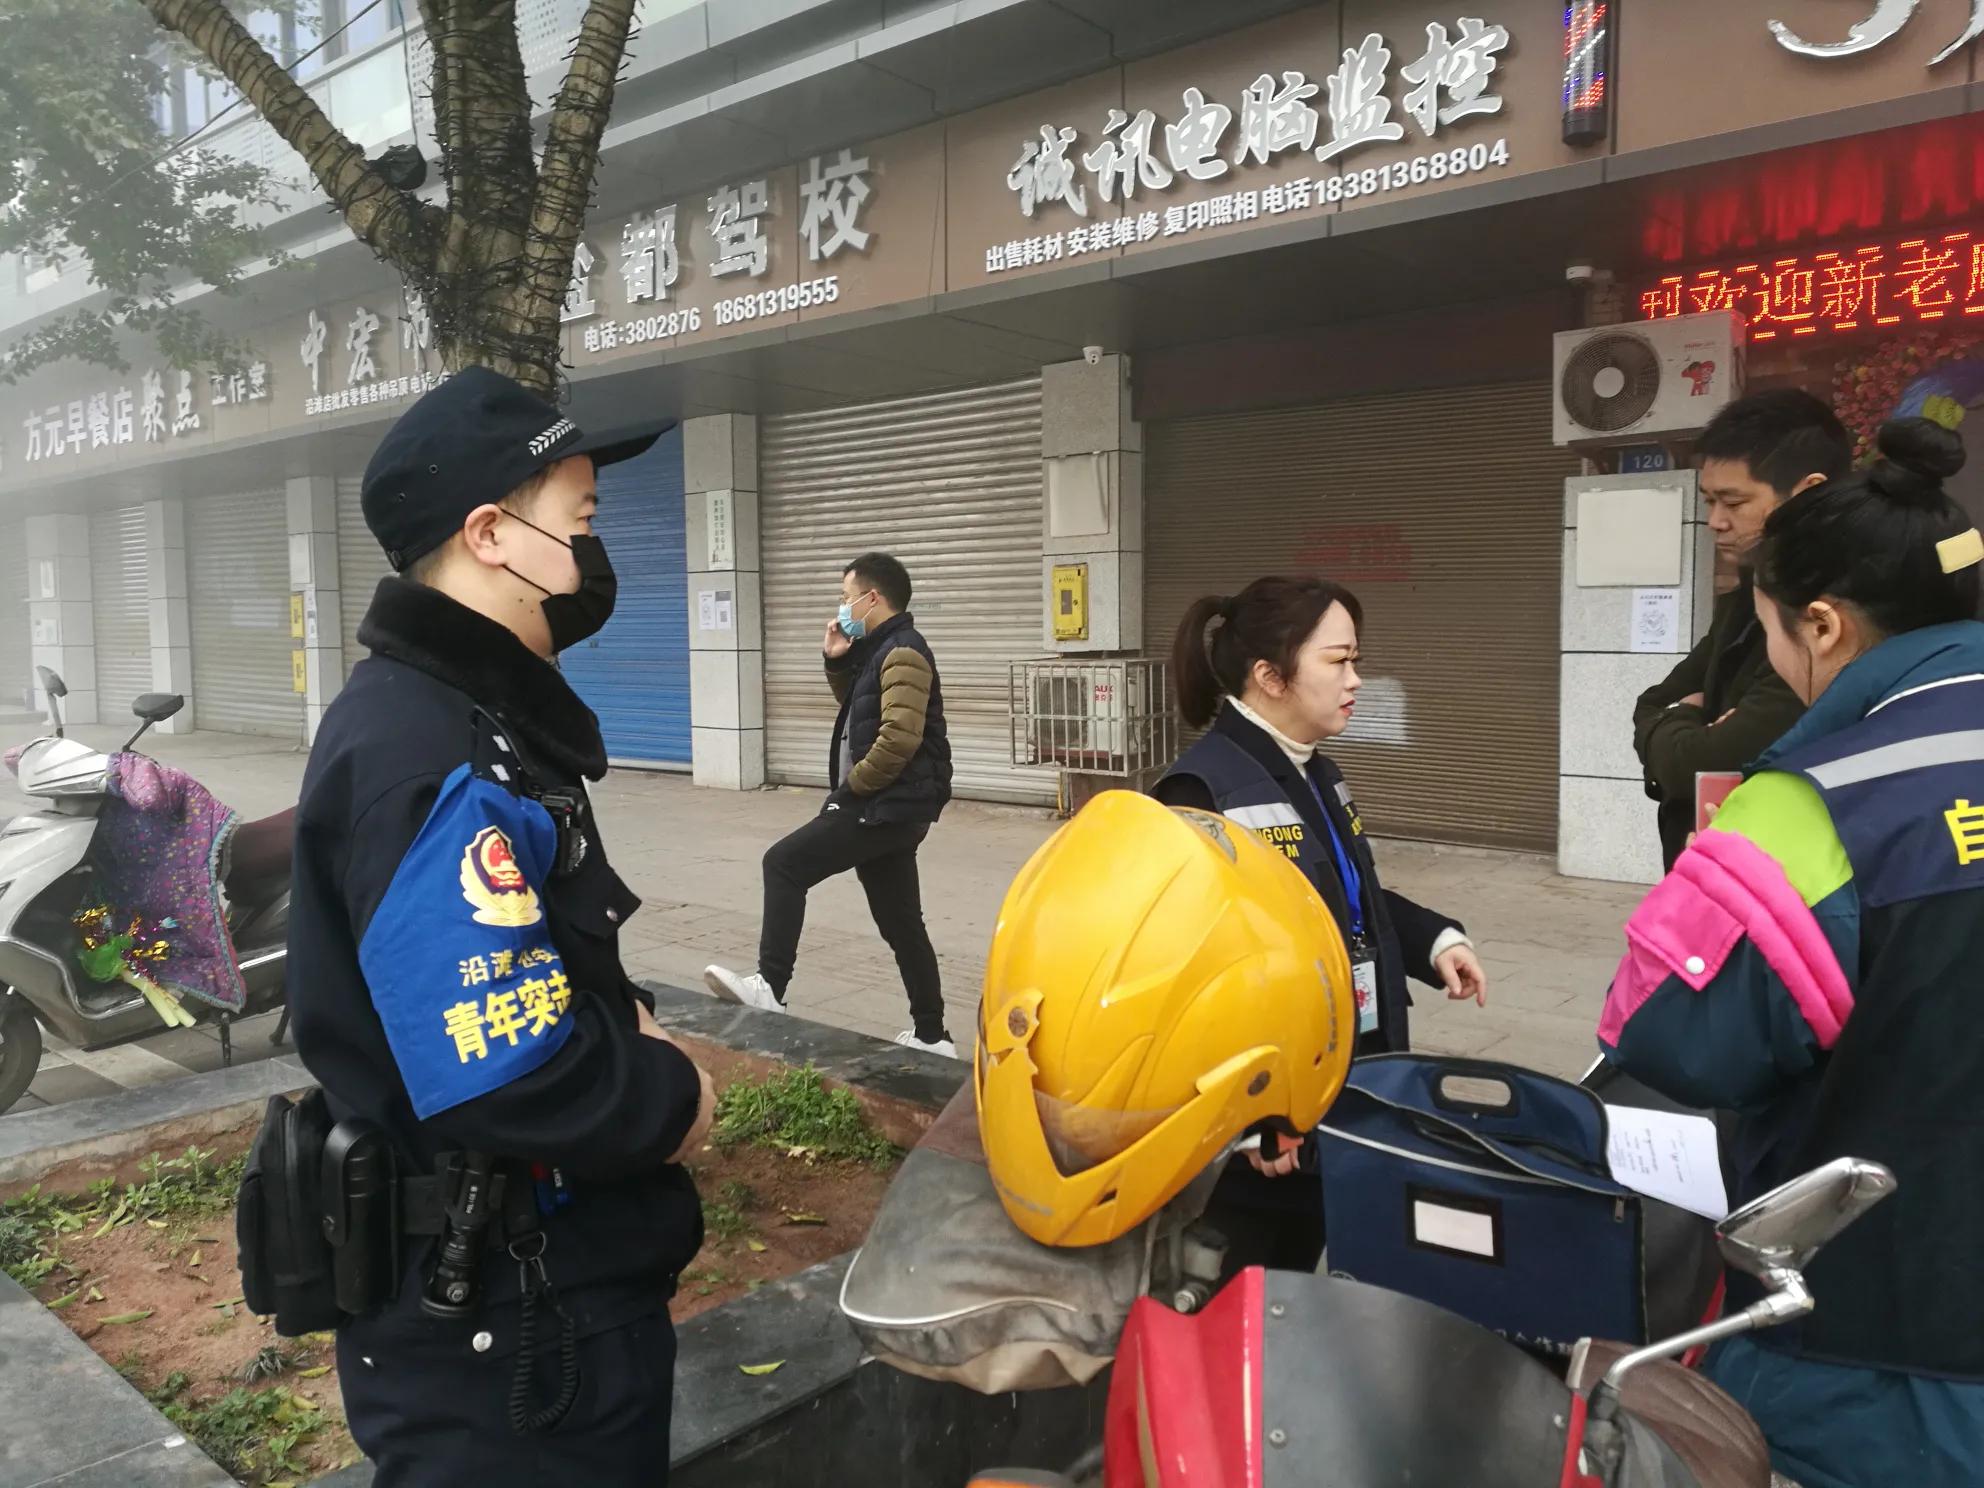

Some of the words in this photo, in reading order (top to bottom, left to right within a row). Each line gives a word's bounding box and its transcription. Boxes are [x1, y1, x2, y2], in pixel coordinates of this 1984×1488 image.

[1007, 17, 1509, 217] 诚讯电脑监控
[985, 231, 1065, 273] 出售耗材
[1067, 211, 1160, 256] 安装维修
[1163, 190, 1258, 237] 复印照相
[584, 307, 701, 352] 电话:3802876
[713, 275, 839, 327] 18681319555
[1642, 243, 1984, 327] 欢迎新老
[23, 386, 134, 461] 方元早餐店
[209, 360, 267, 406] 工作室
[1633, 455, 1665, 469] 120
